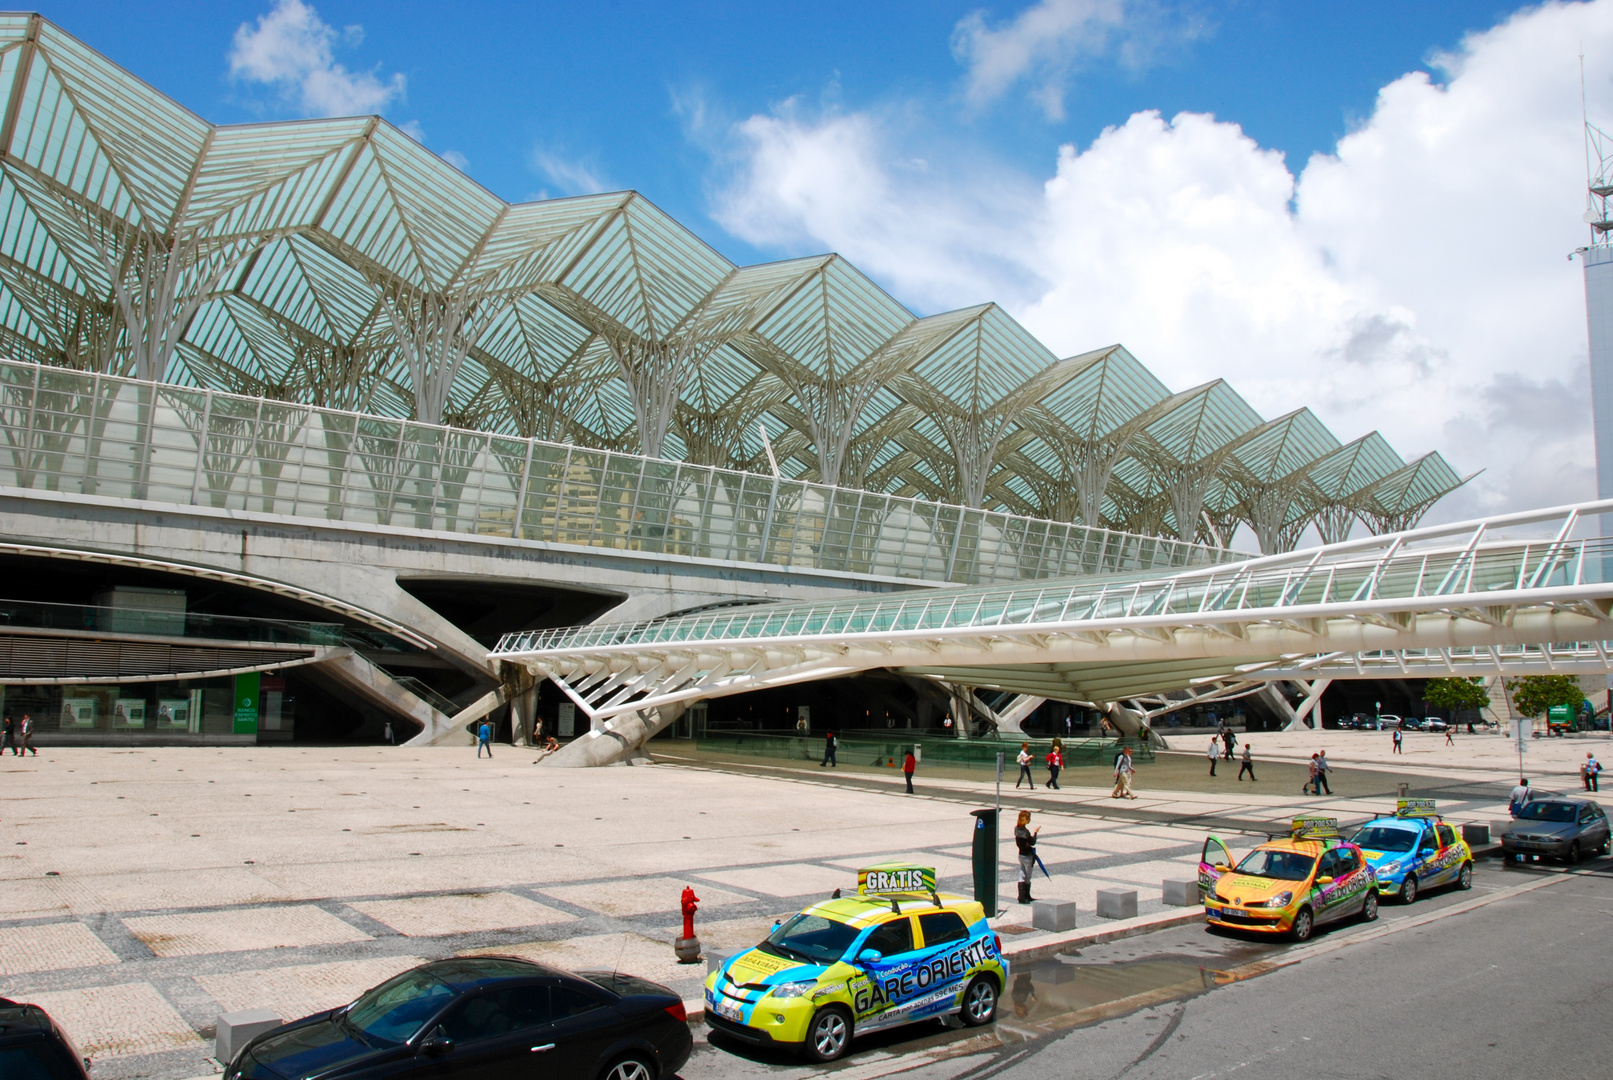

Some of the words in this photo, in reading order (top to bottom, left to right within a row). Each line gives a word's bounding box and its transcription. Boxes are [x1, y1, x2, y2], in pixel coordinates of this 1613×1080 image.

[1326, 819, 1337, 827] 530
[866, 869, 923, 889] GRÁTIS
[853, 971, 914, 1014] GARE
[916, 934, 996, 989] ORIENTE
[878, 1008, 901, 1022] CARTA
[901, 1004, 914, 1015] por
[914, 996, 935, 1010] apenas
[934, 988, 948, 1000] 59€
[948, 982, 964, 995] MÊS
